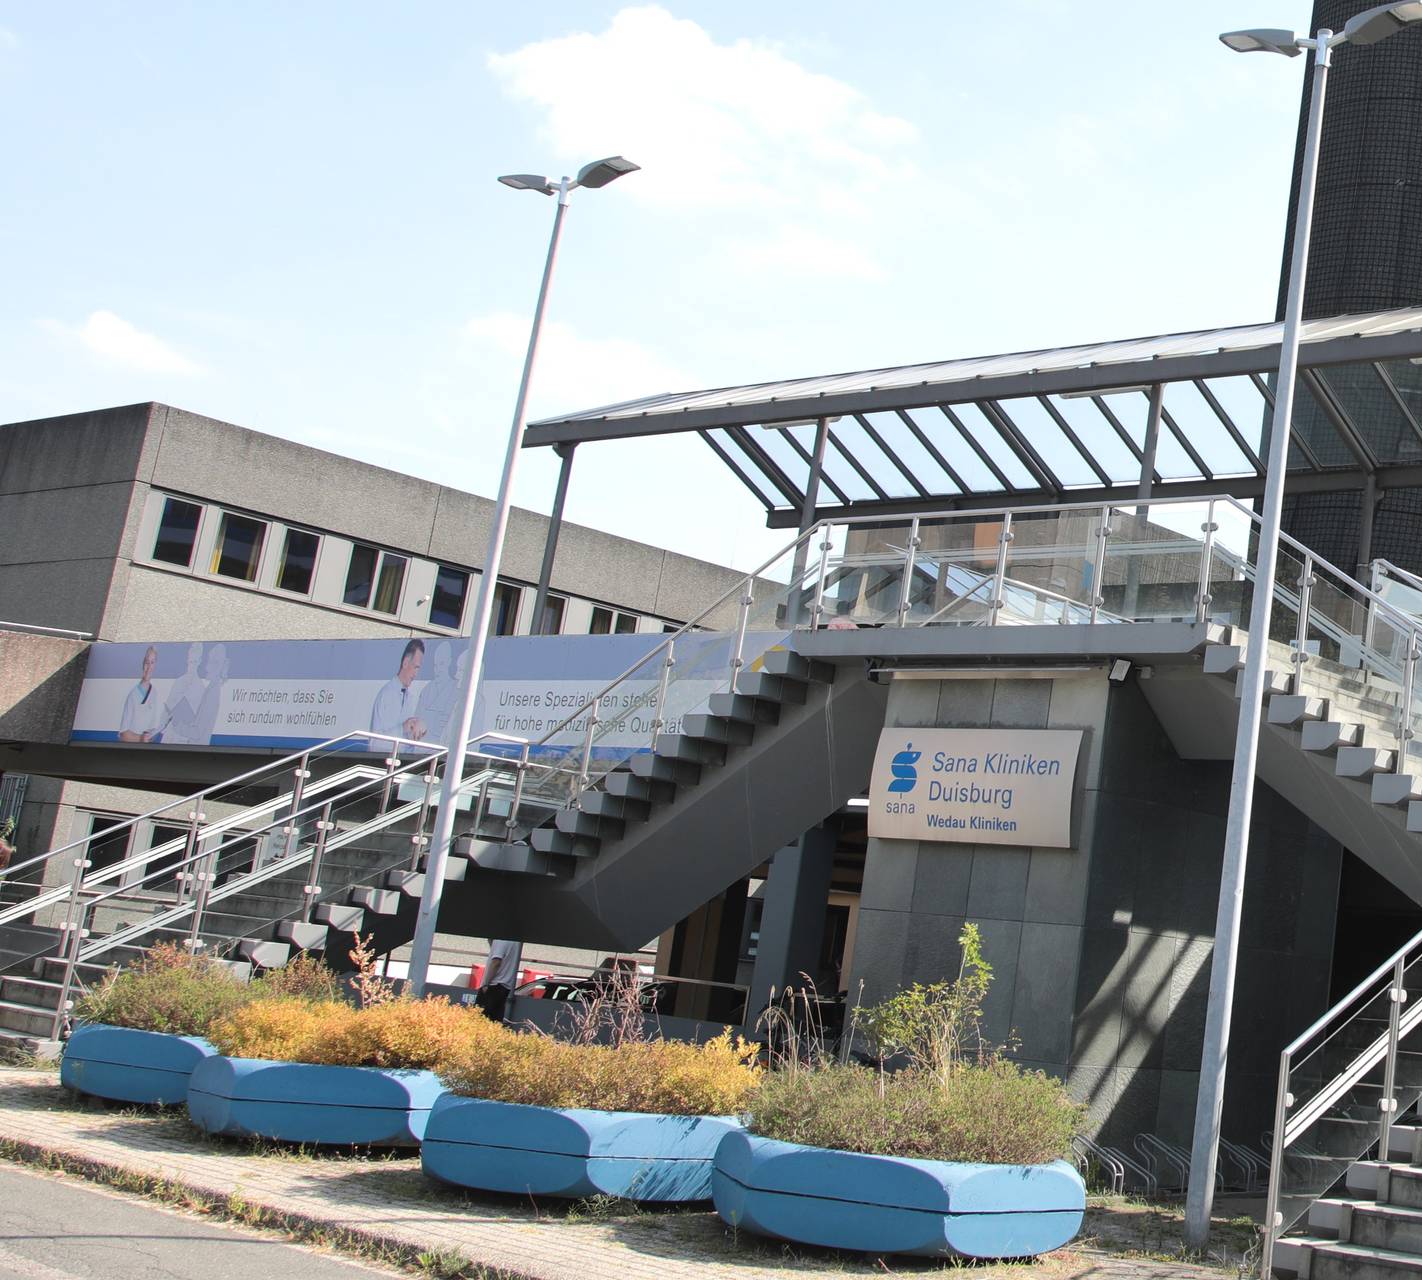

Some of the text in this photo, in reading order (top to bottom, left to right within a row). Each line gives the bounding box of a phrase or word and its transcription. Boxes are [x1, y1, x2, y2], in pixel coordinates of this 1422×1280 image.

[232, 689, 334, 704] Wir möchten, dass Sie
[500, 691, 540, 707] Unsere
[227, 711, 336, 726] sich rundum wohlfühlen
[495, 715, 511, 731] für
[513, 716, 542, 731] hohe
[932, 752, 1060, 775] Sana Kliniken
[929, 781, 1013, 809] Duisburg
[886, 802, 915, 814] sana
[927, 815, 1017, 831] Wedau Kliniken
